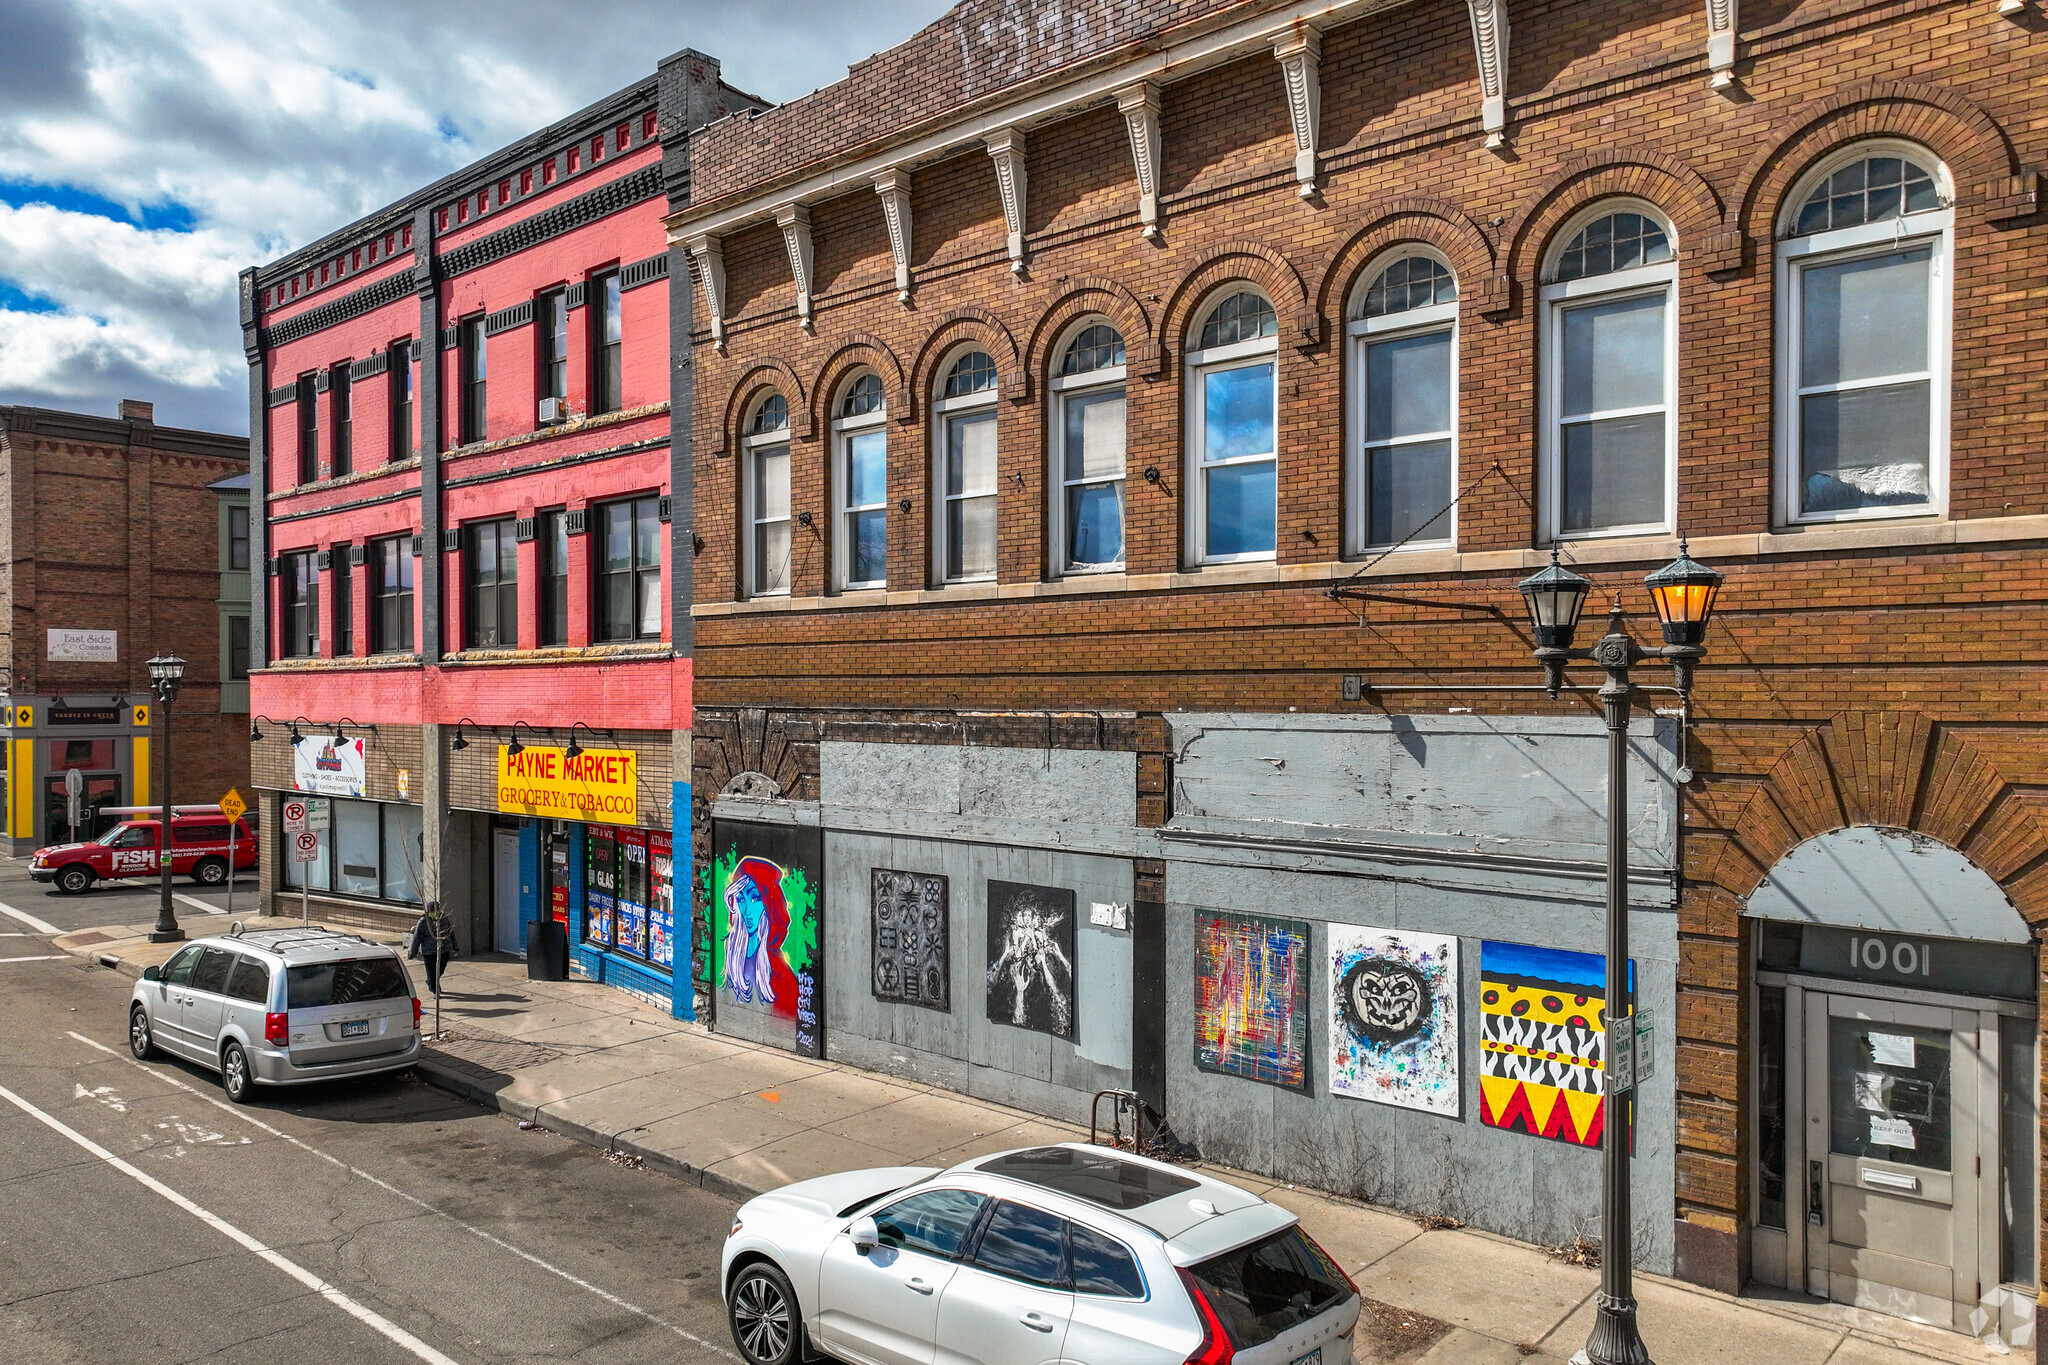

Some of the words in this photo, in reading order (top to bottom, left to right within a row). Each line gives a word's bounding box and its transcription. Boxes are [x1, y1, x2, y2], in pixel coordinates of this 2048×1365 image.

[64, 634, 85, 643] East
[87, 634, 111, 644] Side
[507, 752, 556, 779] PAYNE
[563, 754, 630, 785] MARKET
[302, 772, 318, 780] CLOTHING
[335, 775, 358, 783] ACCESSORIES
[225, 799, 241, 807] DEAD
[227, 808, 238, 816] END
[595, 848, 609, 861] OPEN
[588, 891, 601, 904] DAIRY
[1851, 937, 1930, 976] 1001
[1616, 1026, 1620, 1040] 2
[1615, 1037, 1631, 1056] PARKING
[1619, 1054, 1628, 1064] ENDS
[1619, 1063, 1628, 1073] HERE
[1287, 1321, 1340, 1353] VOLVO
